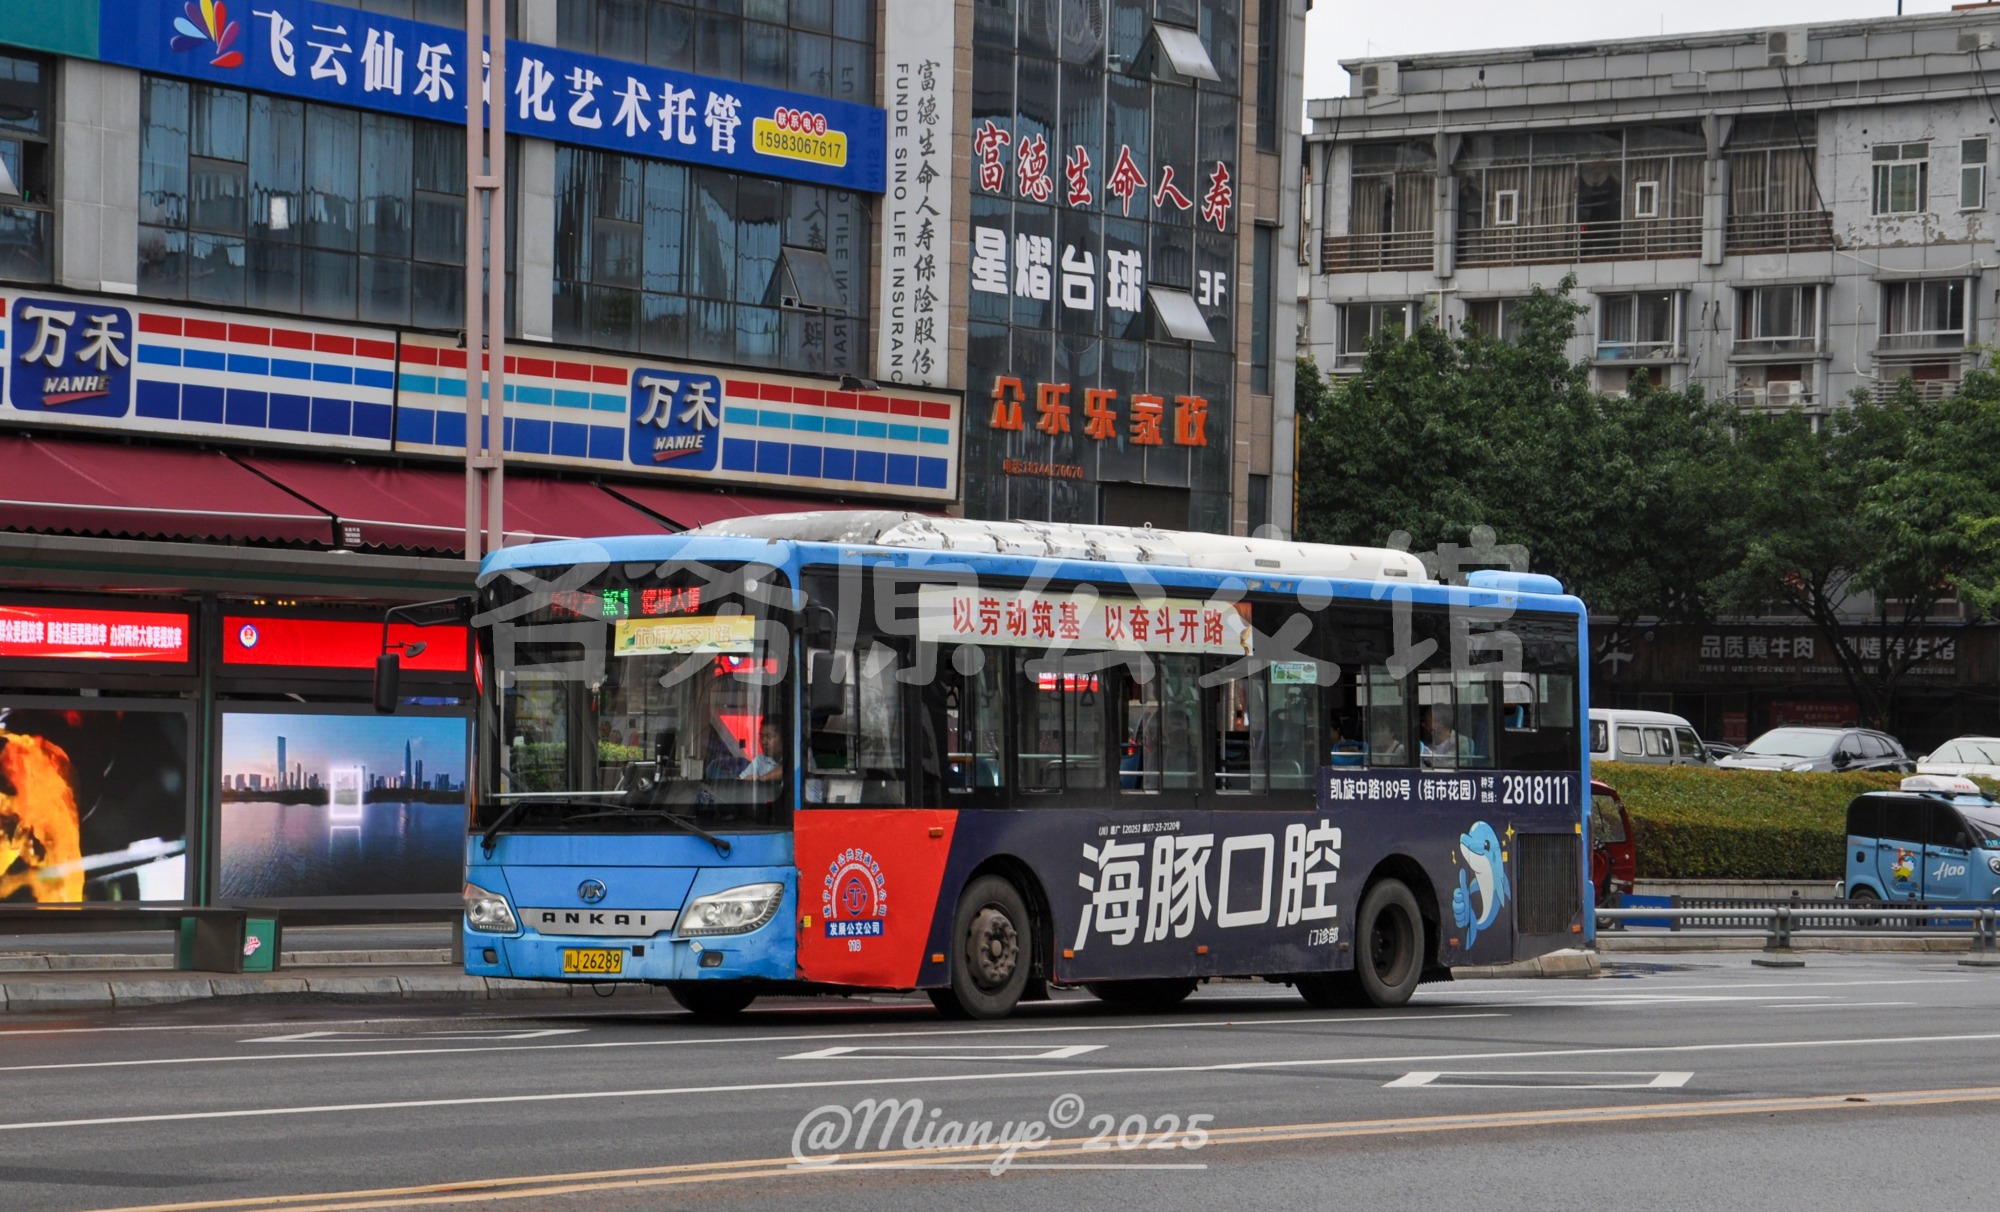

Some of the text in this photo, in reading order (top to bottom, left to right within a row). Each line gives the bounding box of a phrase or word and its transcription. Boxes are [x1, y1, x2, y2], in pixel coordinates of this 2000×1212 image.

[252, 9, 742, 154] 飞云仙乐化艺术托管
[896, 63, 909, 137] FUNDE
[759, 130, 841, 159] 15983067617
[777, 112, 824, 133] 联系电话
[894, 147, 907, 200] SINO
[974, 119, 1232, 232] 富德生命人寿
[893, 211, 906, 257] LIFE
[912, 59, 941, 386] 富德生命人寿保险股份
[971, 225, 1143, 313] 星熠台球
[1198, 269, 1227, 307] 3F
[19, 305, 130, 371] 万禾
[42, 375, 111, 393] WANHE
[637, 374, 720, 431] 万禾
[989, 375, 1209, 447] 众乐乐家政
[653, 434, 706, 451] WANHE
[952, 596, 1225, 647] 以劳动筑基 以奋斗开路
[1700, 635, 1814, 659] 品质黄牛肉
[1502, 775, 1570, 805] 2818111
[1073, 819, 1343, 952] 海豚口腔
[1932, 861, 1966, 881] Hao
[541, 911, 647, 927] ANKAI
[829, 921, 880, 937] 发展公交公司
[1307, 926, 1339, 947] 门诊部
